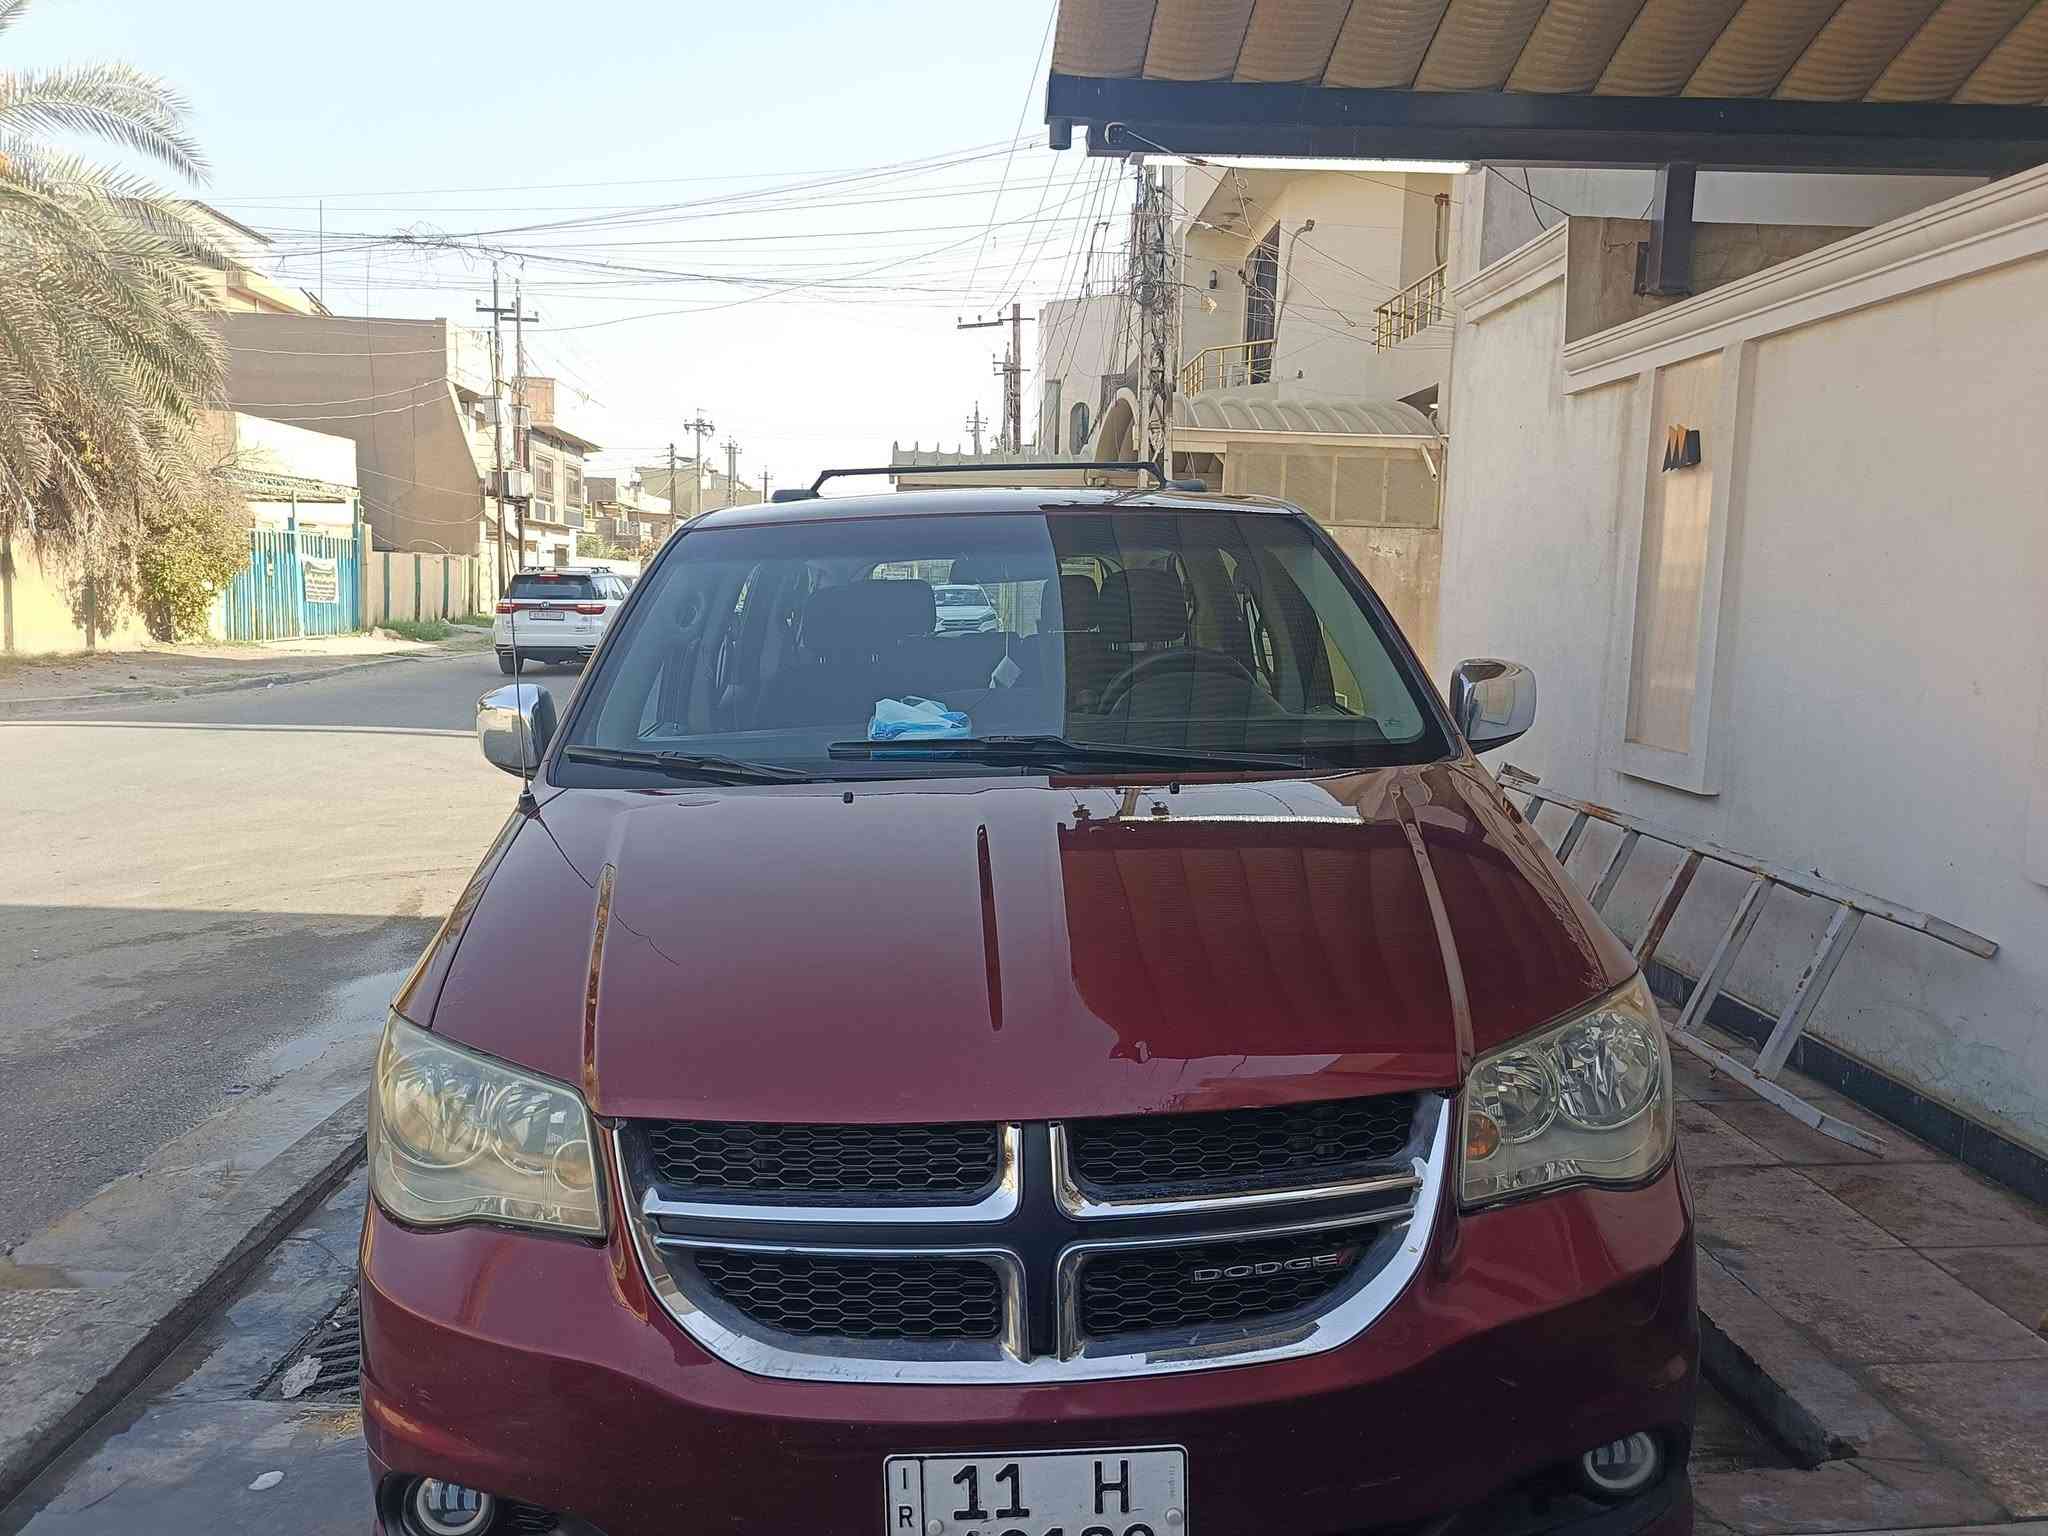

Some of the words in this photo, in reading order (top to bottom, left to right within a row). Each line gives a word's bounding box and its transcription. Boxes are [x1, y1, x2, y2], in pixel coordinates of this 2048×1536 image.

[1194, 1253, 1337, 1281] DODGE
[952, 1464, 1030, 1520] 11
[1094, 1459, 1129, 1514] H
